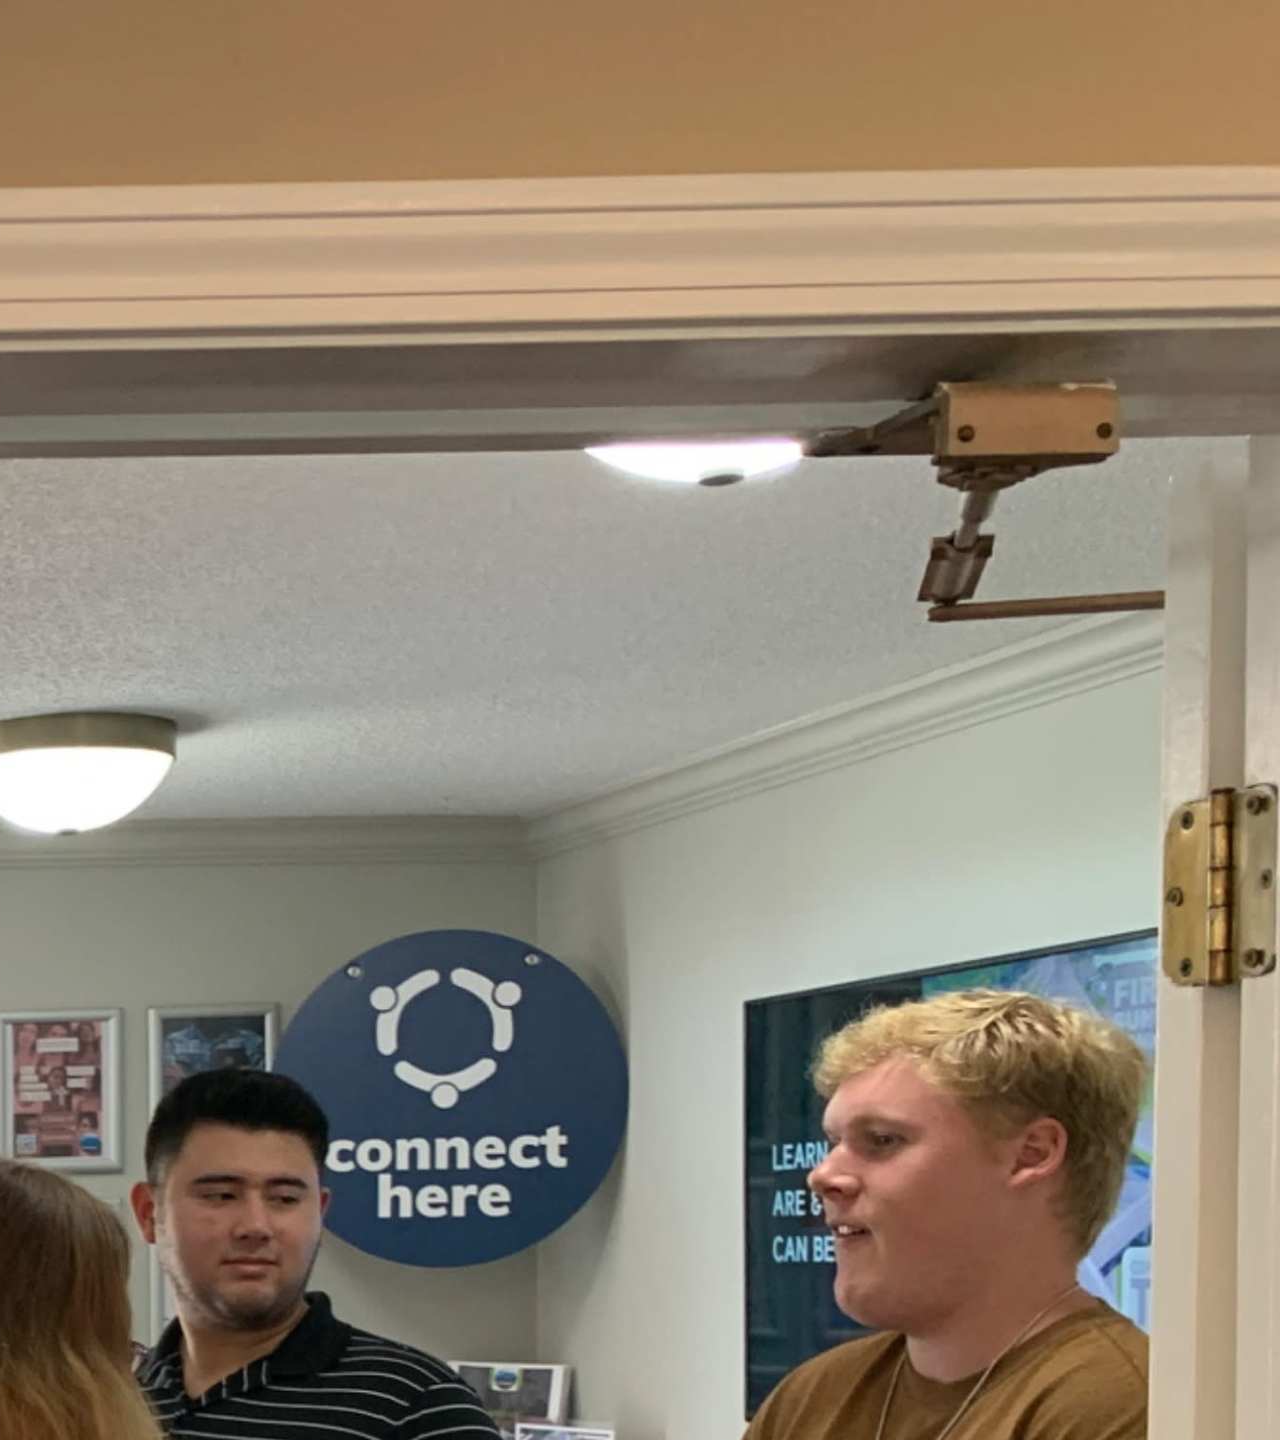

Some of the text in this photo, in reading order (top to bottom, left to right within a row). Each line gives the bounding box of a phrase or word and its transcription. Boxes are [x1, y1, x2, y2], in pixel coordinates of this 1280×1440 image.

[324, 1125, 569, 1173] connect
[772, 1141, 829, 1171] LEARN
[376, 1173, 512, 1219] here
[772, 1190, 824, 1217] ARE &
[772, 1235, 836, 1263] CAN BE
